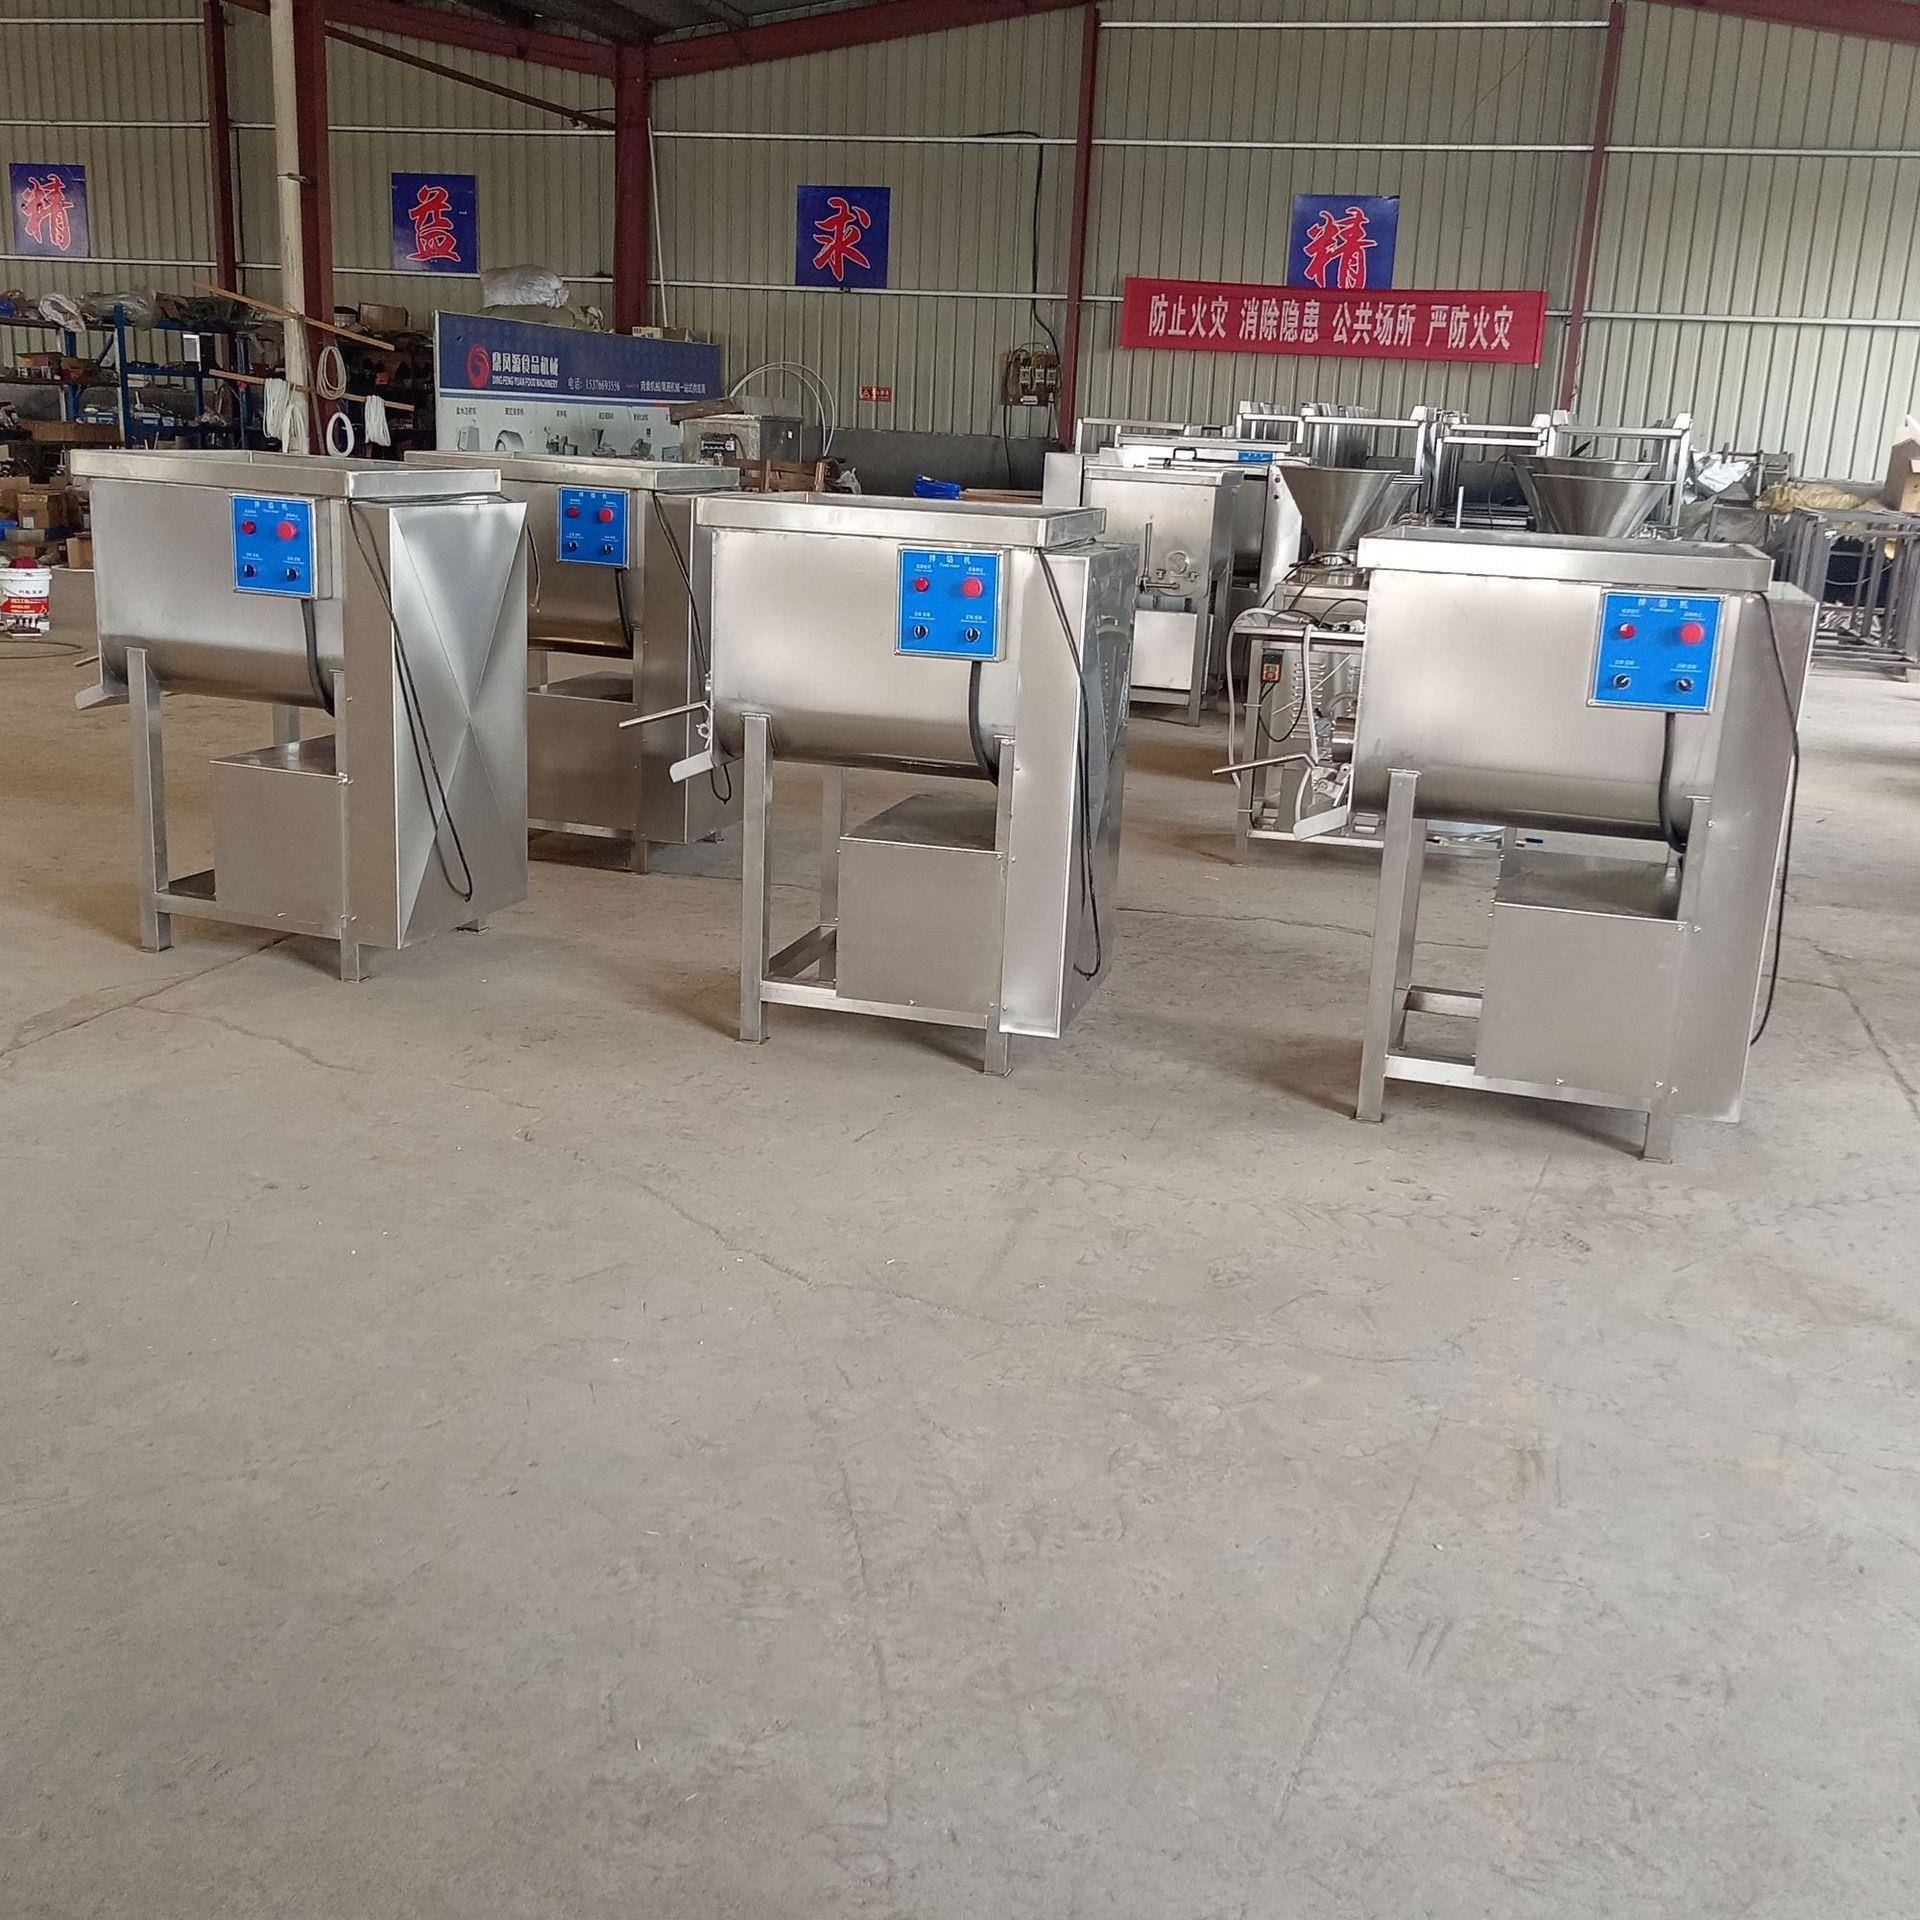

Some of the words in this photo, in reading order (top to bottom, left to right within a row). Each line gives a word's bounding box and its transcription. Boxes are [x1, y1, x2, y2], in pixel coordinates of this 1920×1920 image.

[21, 173, 75, 251] 精
[406, 184, 461, 262] 益
[813, 196, 871, 282] 求
[1303, 205, 1378, 289] 精
[1147, 295, 1228, 339] 防止火灾
[1238, 297, 1319, 345] 消除隐患
[1331, 303, 1416, 348] 公共场所
[1425, 305, 1515, 351] 严防火灾
